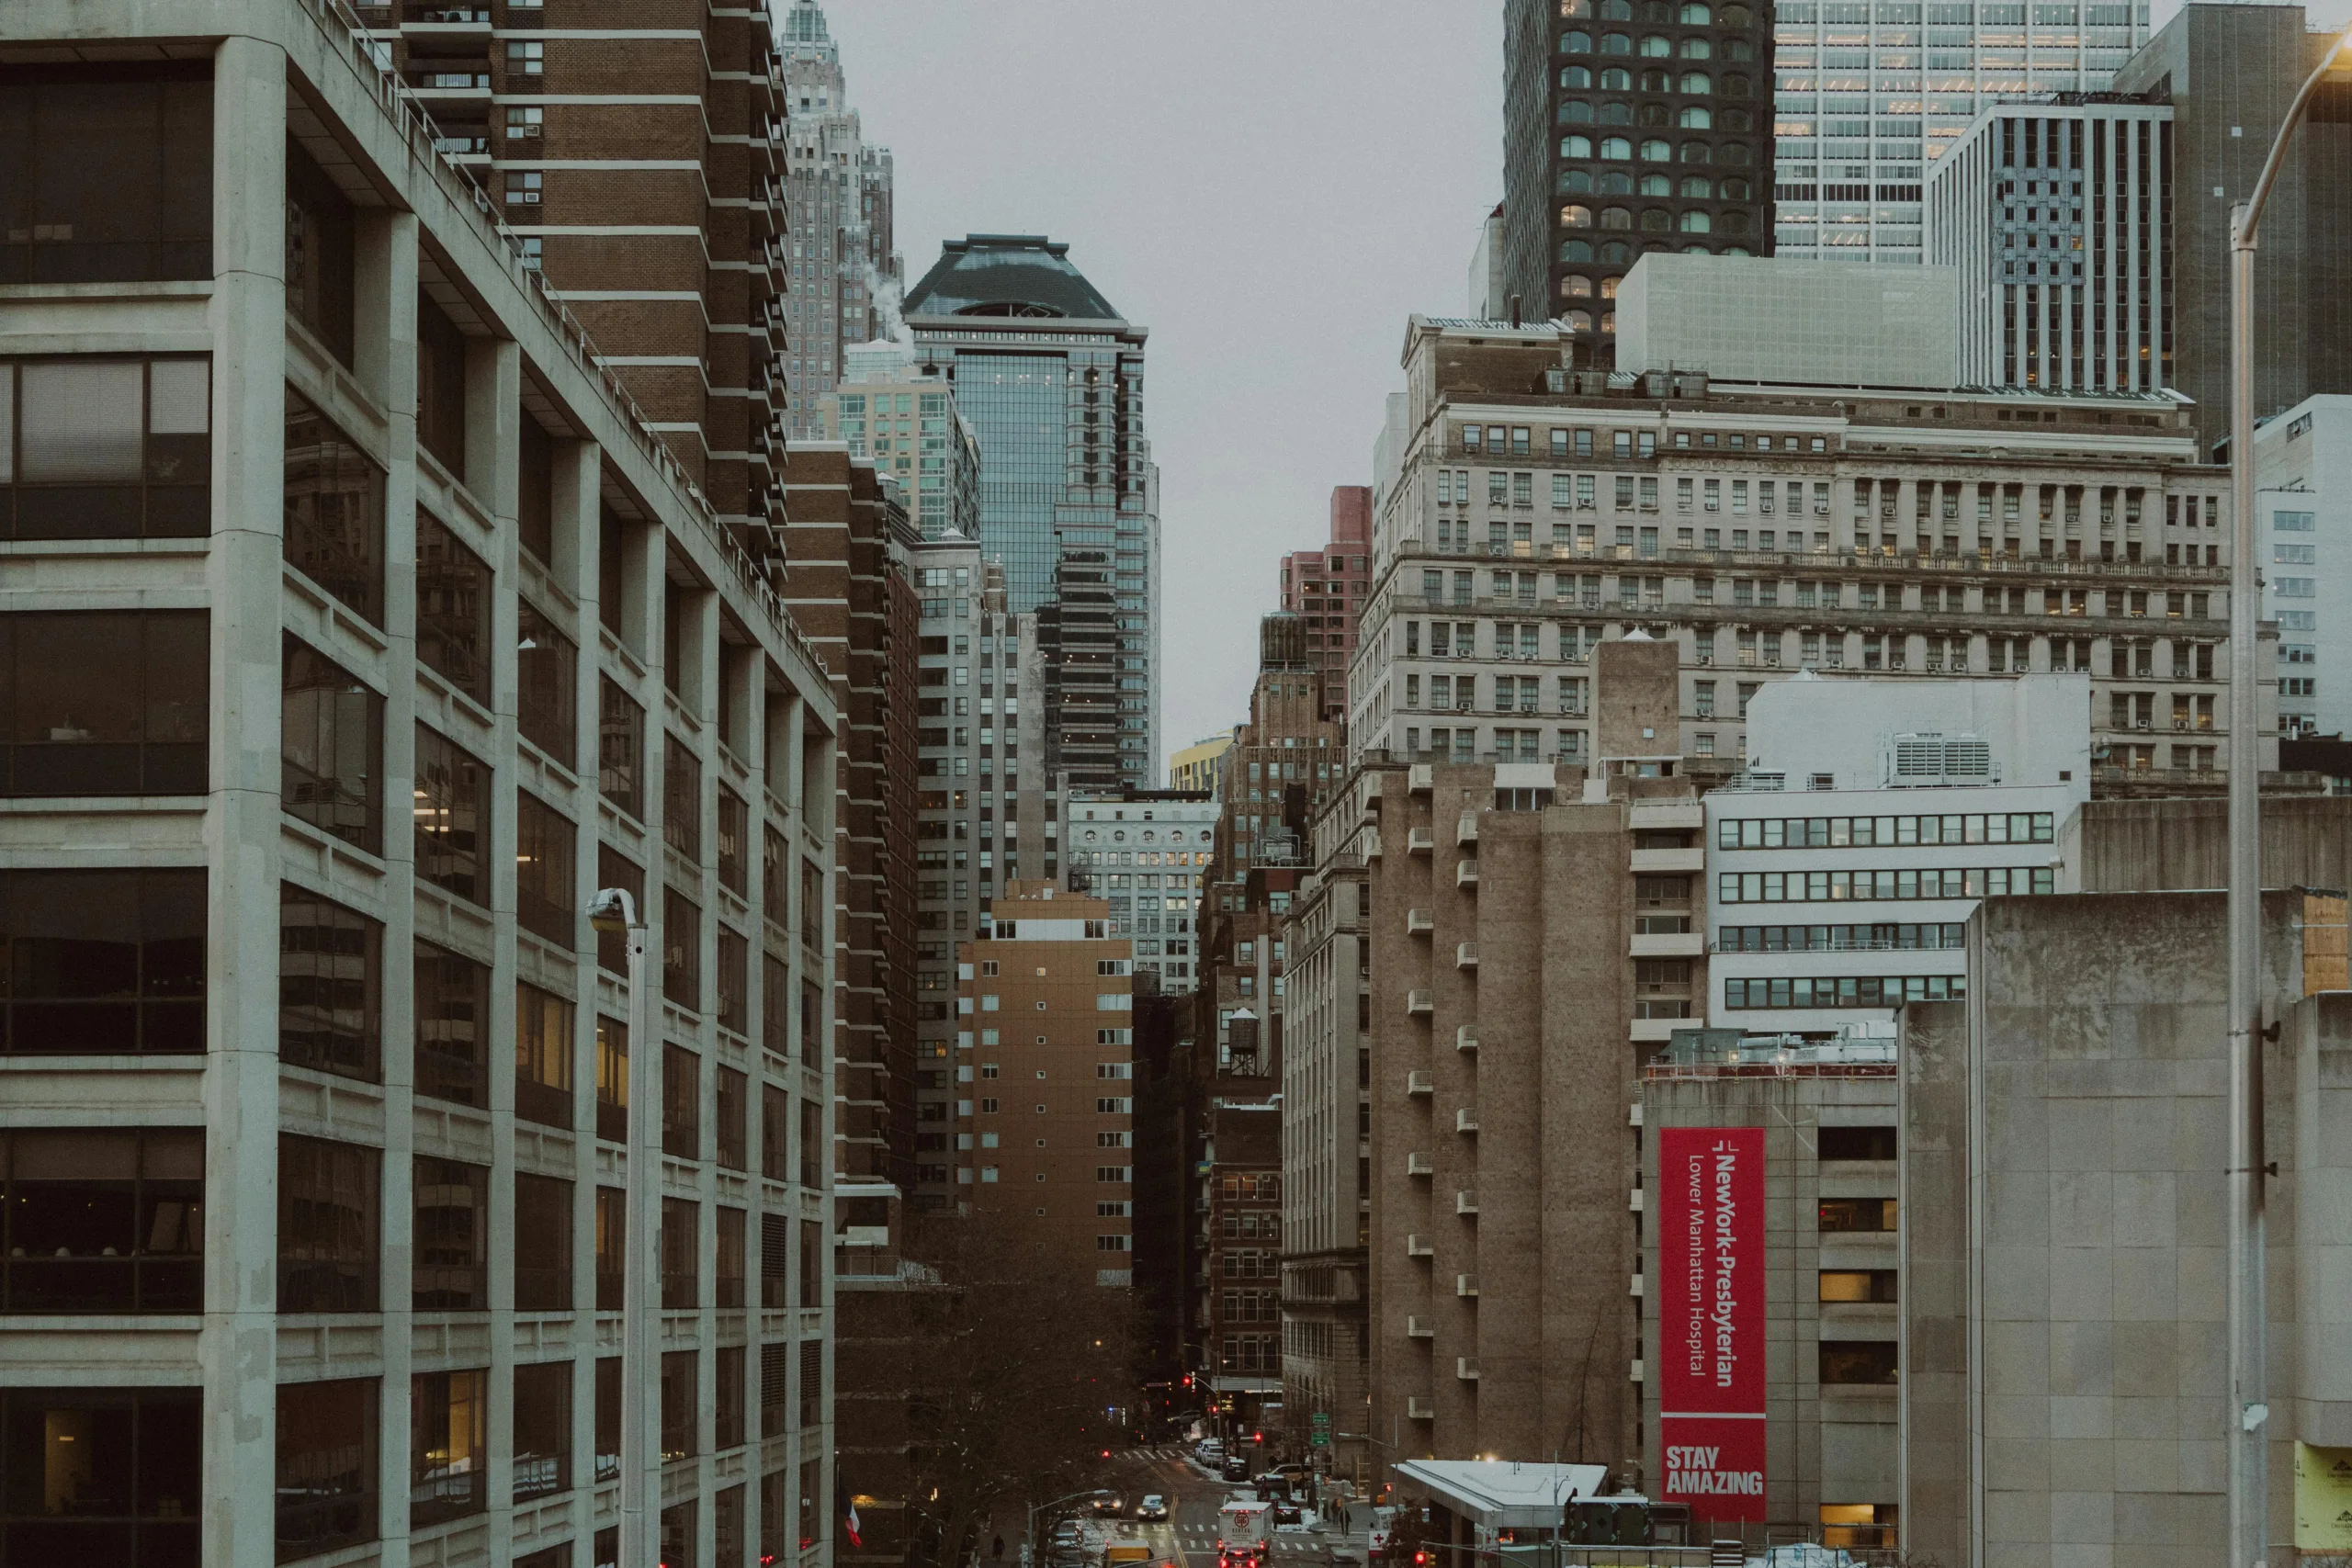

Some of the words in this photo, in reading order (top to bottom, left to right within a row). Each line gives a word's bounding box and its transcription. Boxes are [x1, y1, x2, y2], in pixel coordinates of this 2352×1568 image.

[1689, 1156, 1704, 1205] Lower
[1690, 1209, 1706, 1303] Manhattan
[1711, 1155, 1737, 1387] NewYork-Presbyterian
[1685, 1307, 1706, 1376] Hospital
[1666, 1446, 1720, 1470] STAY
[1666, 1471, 1763, 1495] AMAZING
